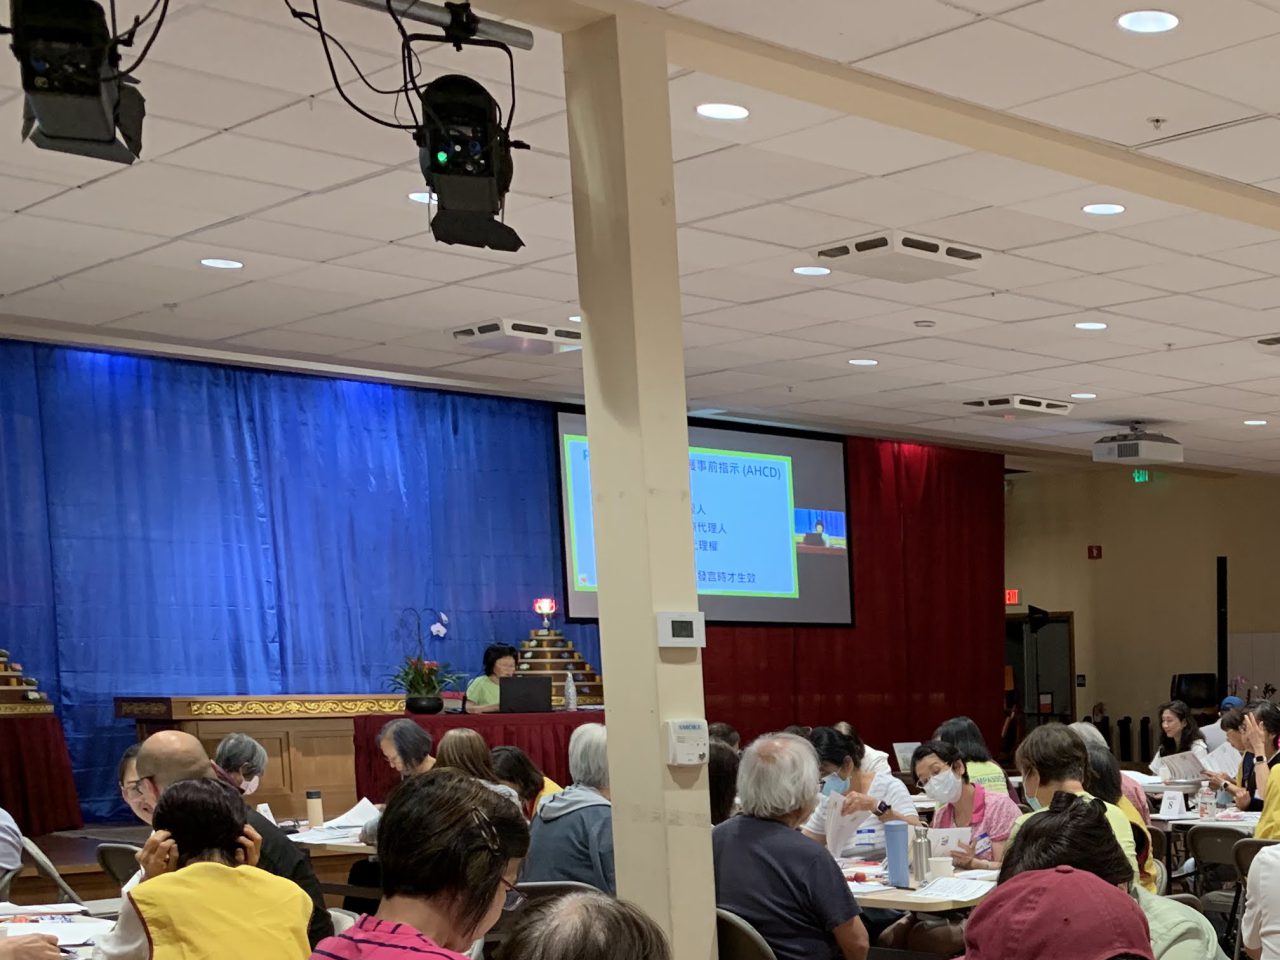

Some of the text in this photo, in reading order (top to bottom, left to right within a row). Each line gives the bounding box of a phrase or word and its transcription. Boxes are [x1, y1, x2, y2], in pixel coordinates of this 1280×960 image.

[743, 464, 781, 480] (AHCD)
[693, 522, 727, 535] 代理人
[694, 540, 718, 552] 理權
